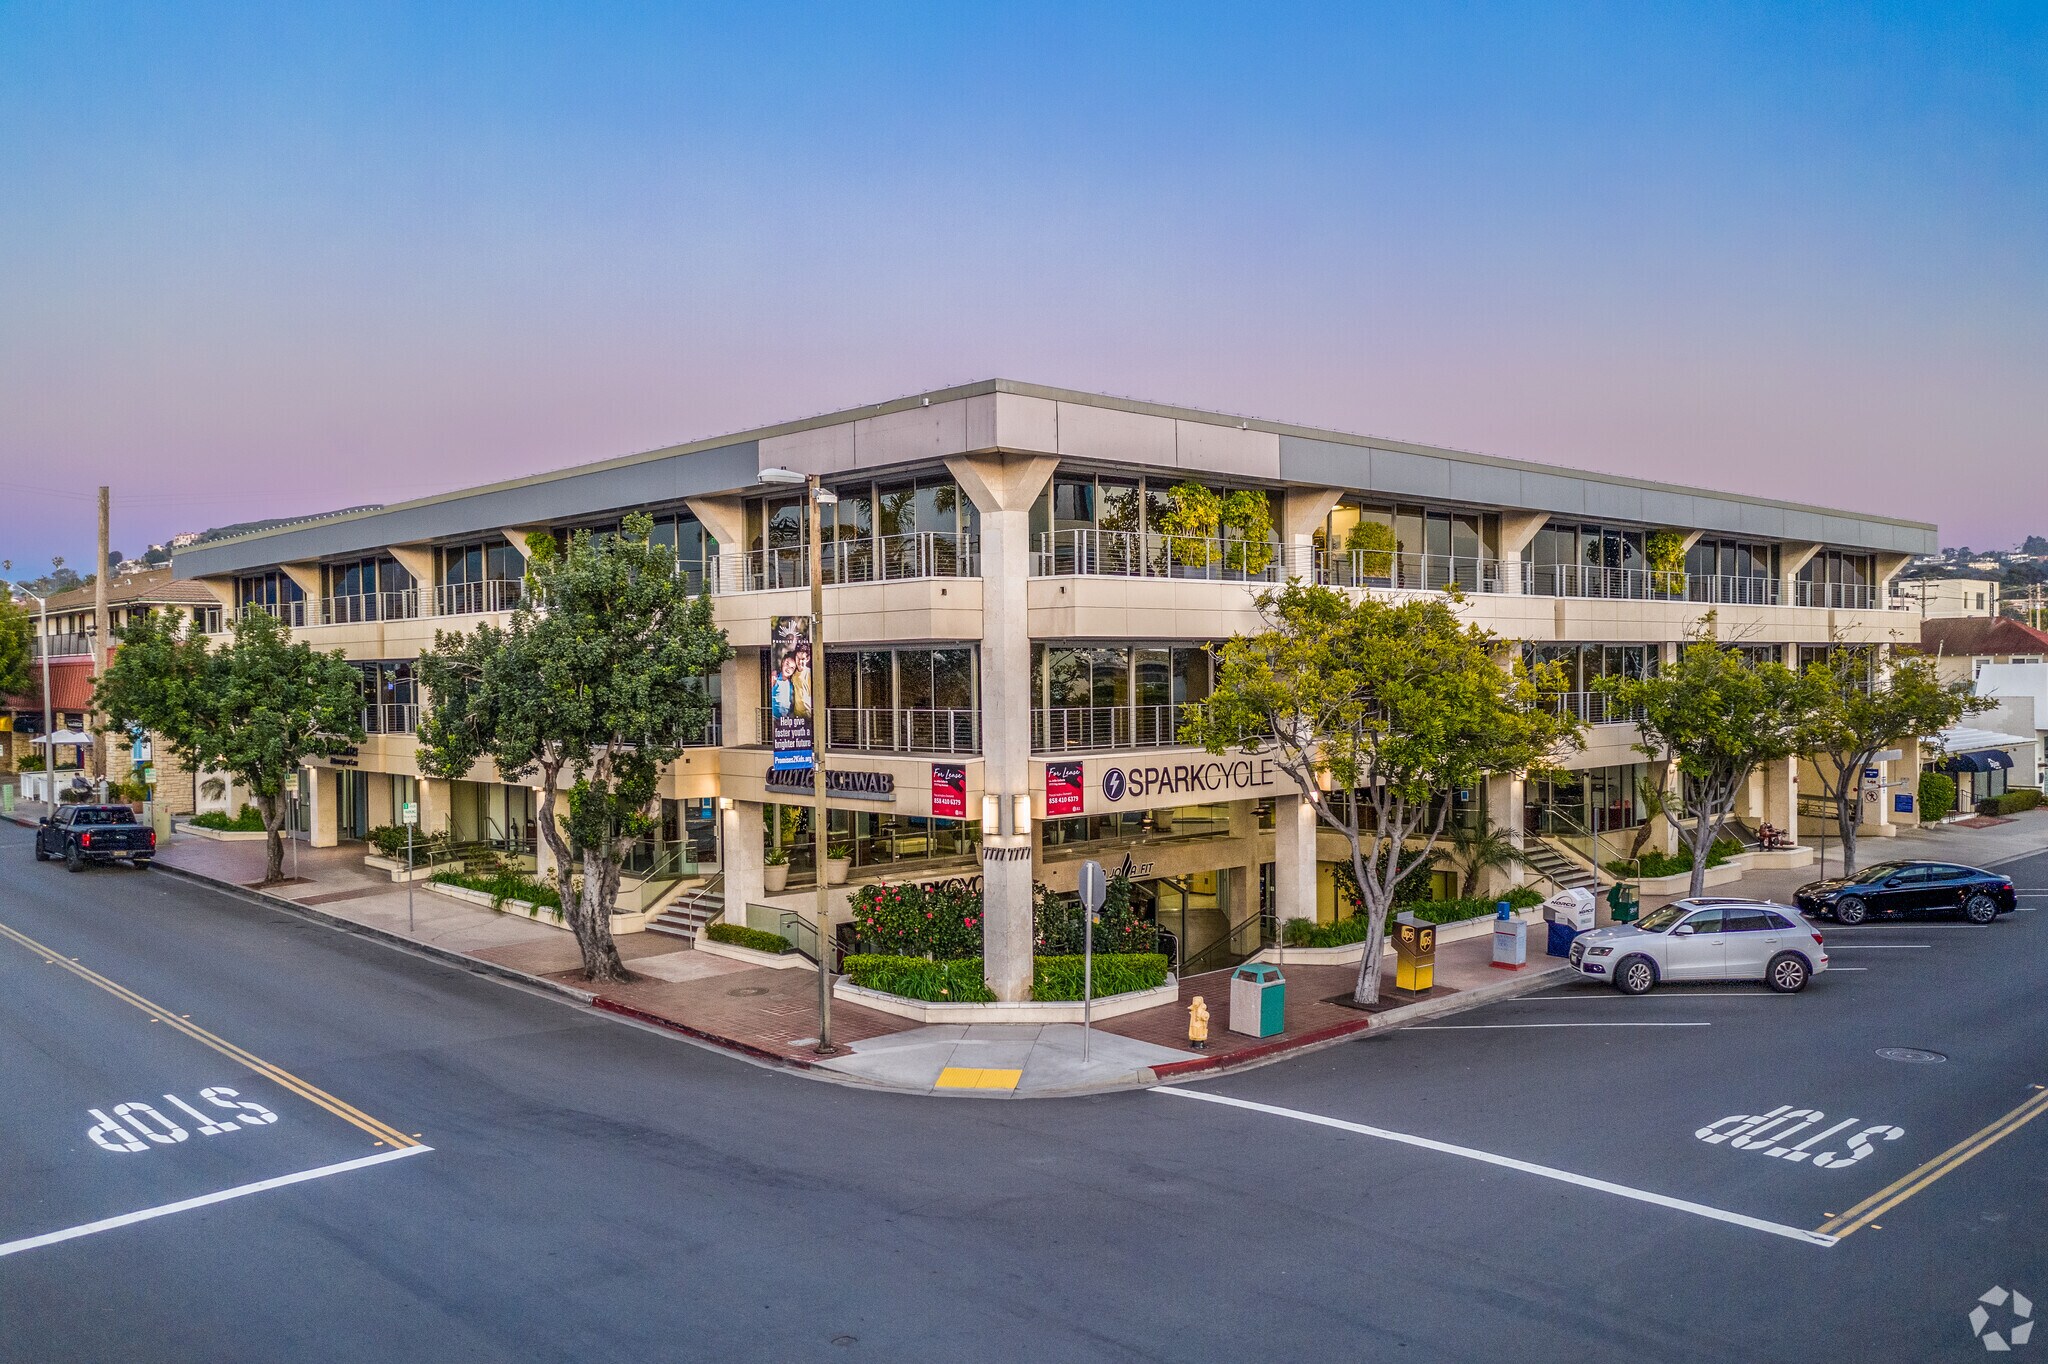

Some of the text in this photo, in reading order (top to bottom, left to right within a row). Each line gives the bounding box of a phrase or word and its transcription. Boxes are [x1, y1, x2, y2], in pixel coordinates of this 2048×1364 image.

[780, 715, 805, 728] Help give
[774, 728, 790, 737] foster
[791, 727, 805, 739] youth
[774, 738, 811, 750] brighter future
[933, 767, 963, 780] For Lease
[1048, 766, 1081, 778] For Lease
[1128, 758, 1274, 798] SPARKCYCLE
[765, 766, 895, 794] Charle SCHWAB
[1140, 862, 1155, 875] FIT
[1550, 900, 1577, 908] NORCO
[1578, 907, 1595, 915] NORCO
[88, 1086, 278, 1153] STOP
[1695, 1104, 1905, 1169] STOP
